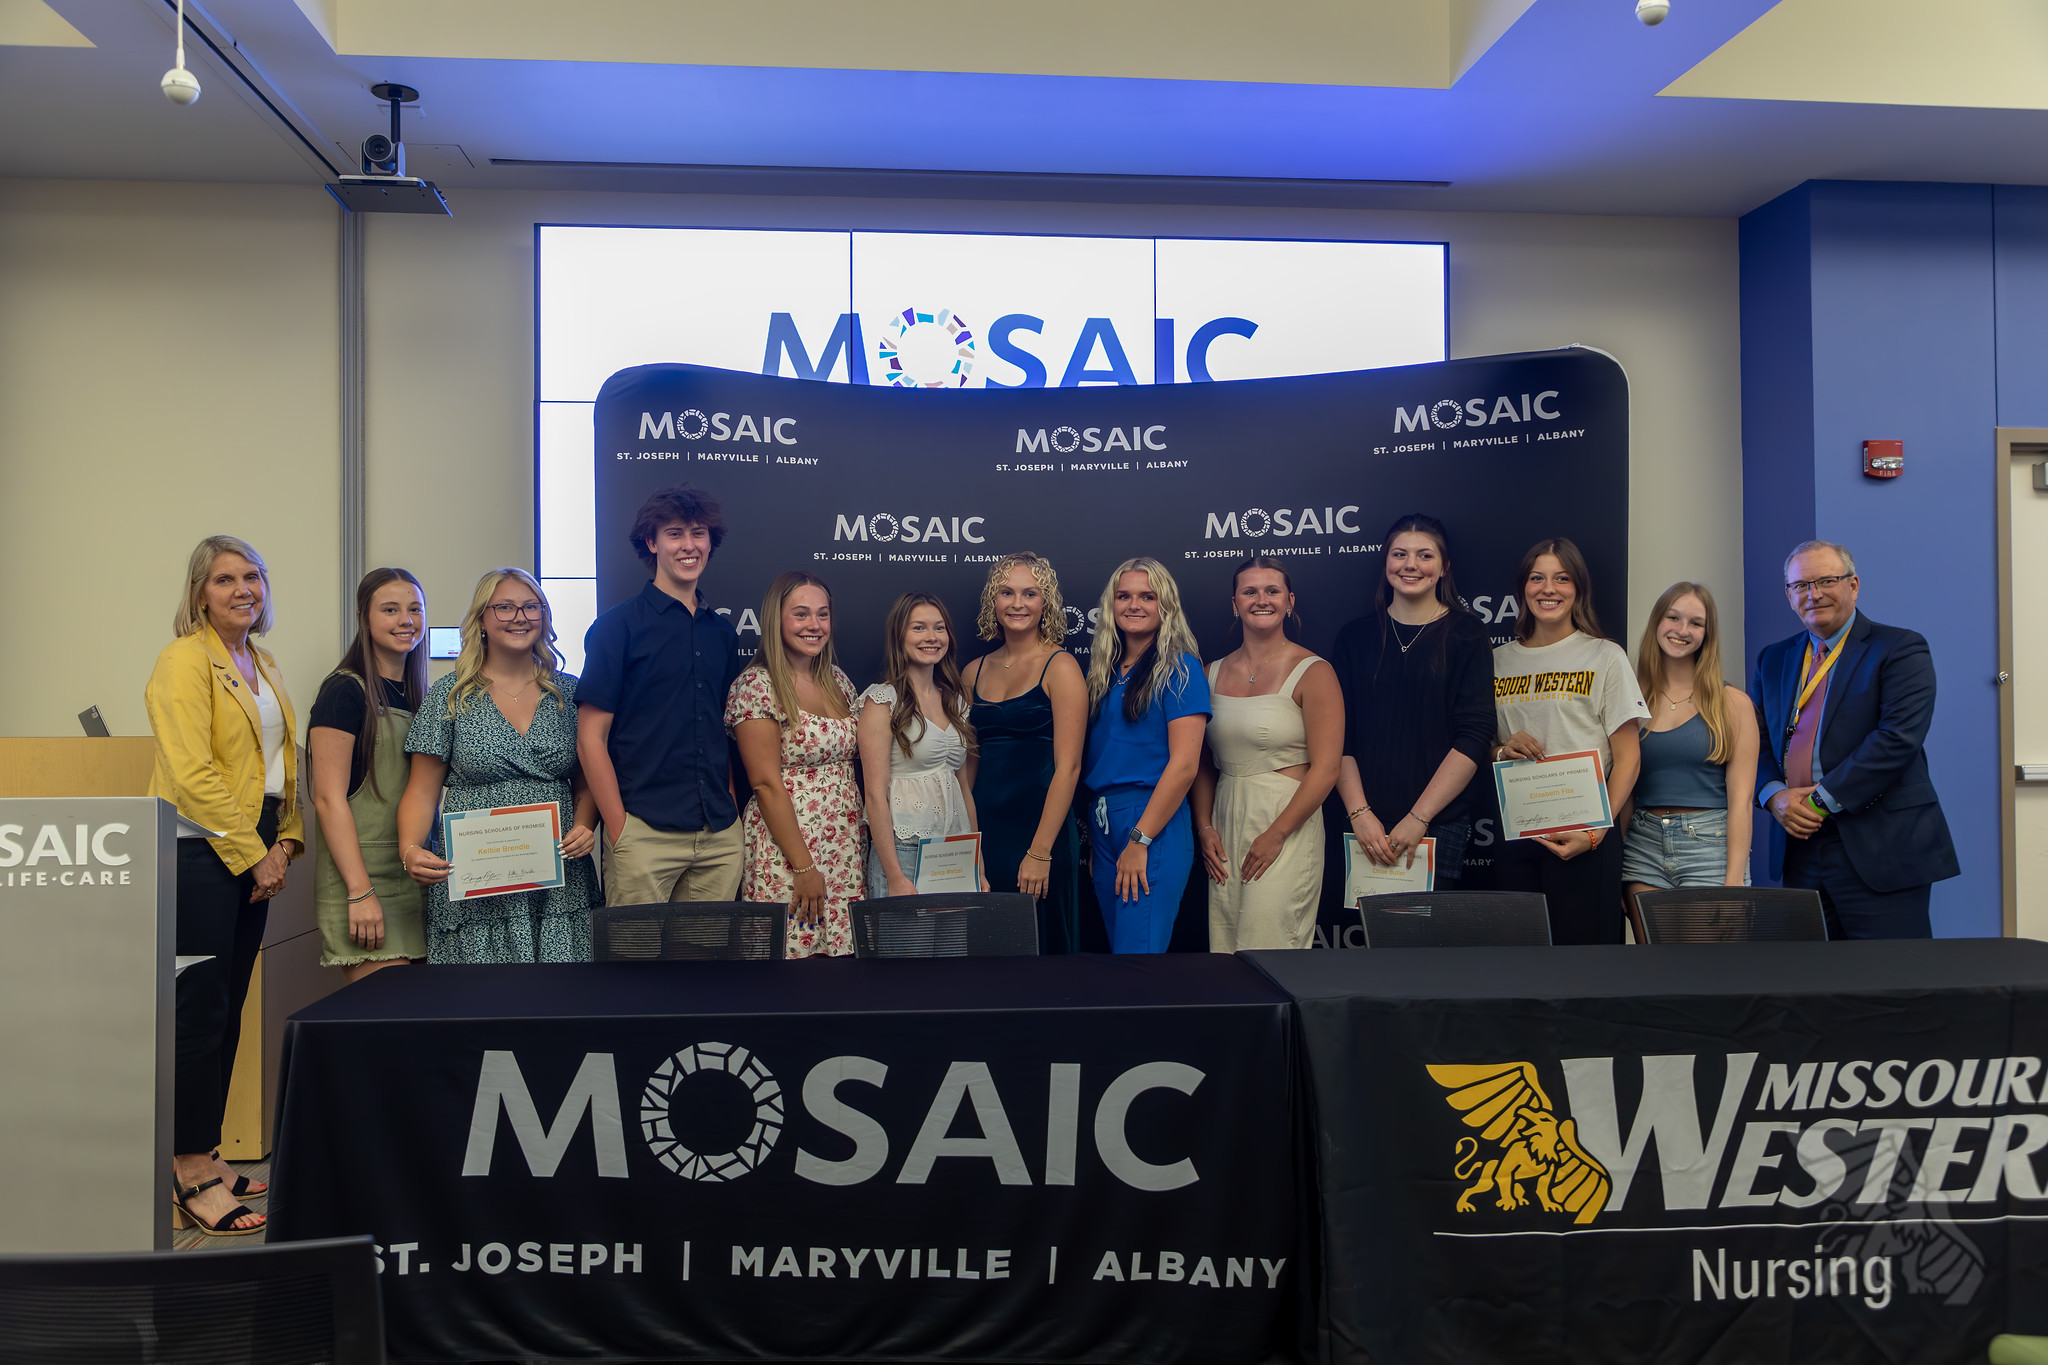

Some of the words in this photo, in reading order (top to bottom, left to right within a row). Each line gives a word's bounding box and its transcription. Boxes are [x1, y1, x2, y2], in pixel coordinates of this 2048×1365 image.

[762, 307, 1259, 389] MOSAIC
[1393, 390, 1561, 434] MOSAIC
[638, 408, 798, 445] MOSAIC
[1015, 425, 1167, 453] MOSAIC
[1373, 447, 1389, 455] ST.
[1393, 443, 1435, 453] JOSEPH
[1453, 436, 1518, 448] MARYVILLE
[1537, 429, 1585, 441] ALBANY
[617, 452, 633, 460] ST.
[637, 452, 679, 460] JOSEPH
[698, 453, 759, 462] MARYVILLE
[776, 456, 819, 466] ALBANY
[1070, 462, 1129, 471] MARYVILLE
[1146, 460, 1189, 469] ALBANY
[833, 512, 986, 544] MOSAIC
[1205, 505, 1361, 539] MOSAIC
[813, 552, 829, 560] ST.
[832, 553, 872, 561] JOSEPH
[889, 554, 947, 562] MARYVILLE
[1184, 551, 1200, 559] ST.
[1203, 550, 1244, 558] JOSEPH
[1260, 547, 1321, 557] MARYVILLE
[1338, 544, 1382, 553] ALBANY
[1533, 670, 1596, 697] WESTERN
[1496, 697, 1516, 706] TATE
[1519, 692, 1574, 702] UNIVERSITY
[1529, 790, 1560, 799] Elizabeth
[459, 828, 483, 837] NURSING
[484, 826, 512, 834] SCHOLARS
[502, 844, 530, 852] Brendle
[1372, 867, 1388, 875] Chloe
[461, 1041, 1206, 1192] MOSAIC
[1560, 1053, 2048, 1212] WESTER
[451, 1242, 644, 1276] JOSEPH
[731, 1246, 1012, 1281] MARYVILLE
[1093, 1250, 1287, 1289] ALBANY
[1693, 1244, 1892, 1310] Nursing
